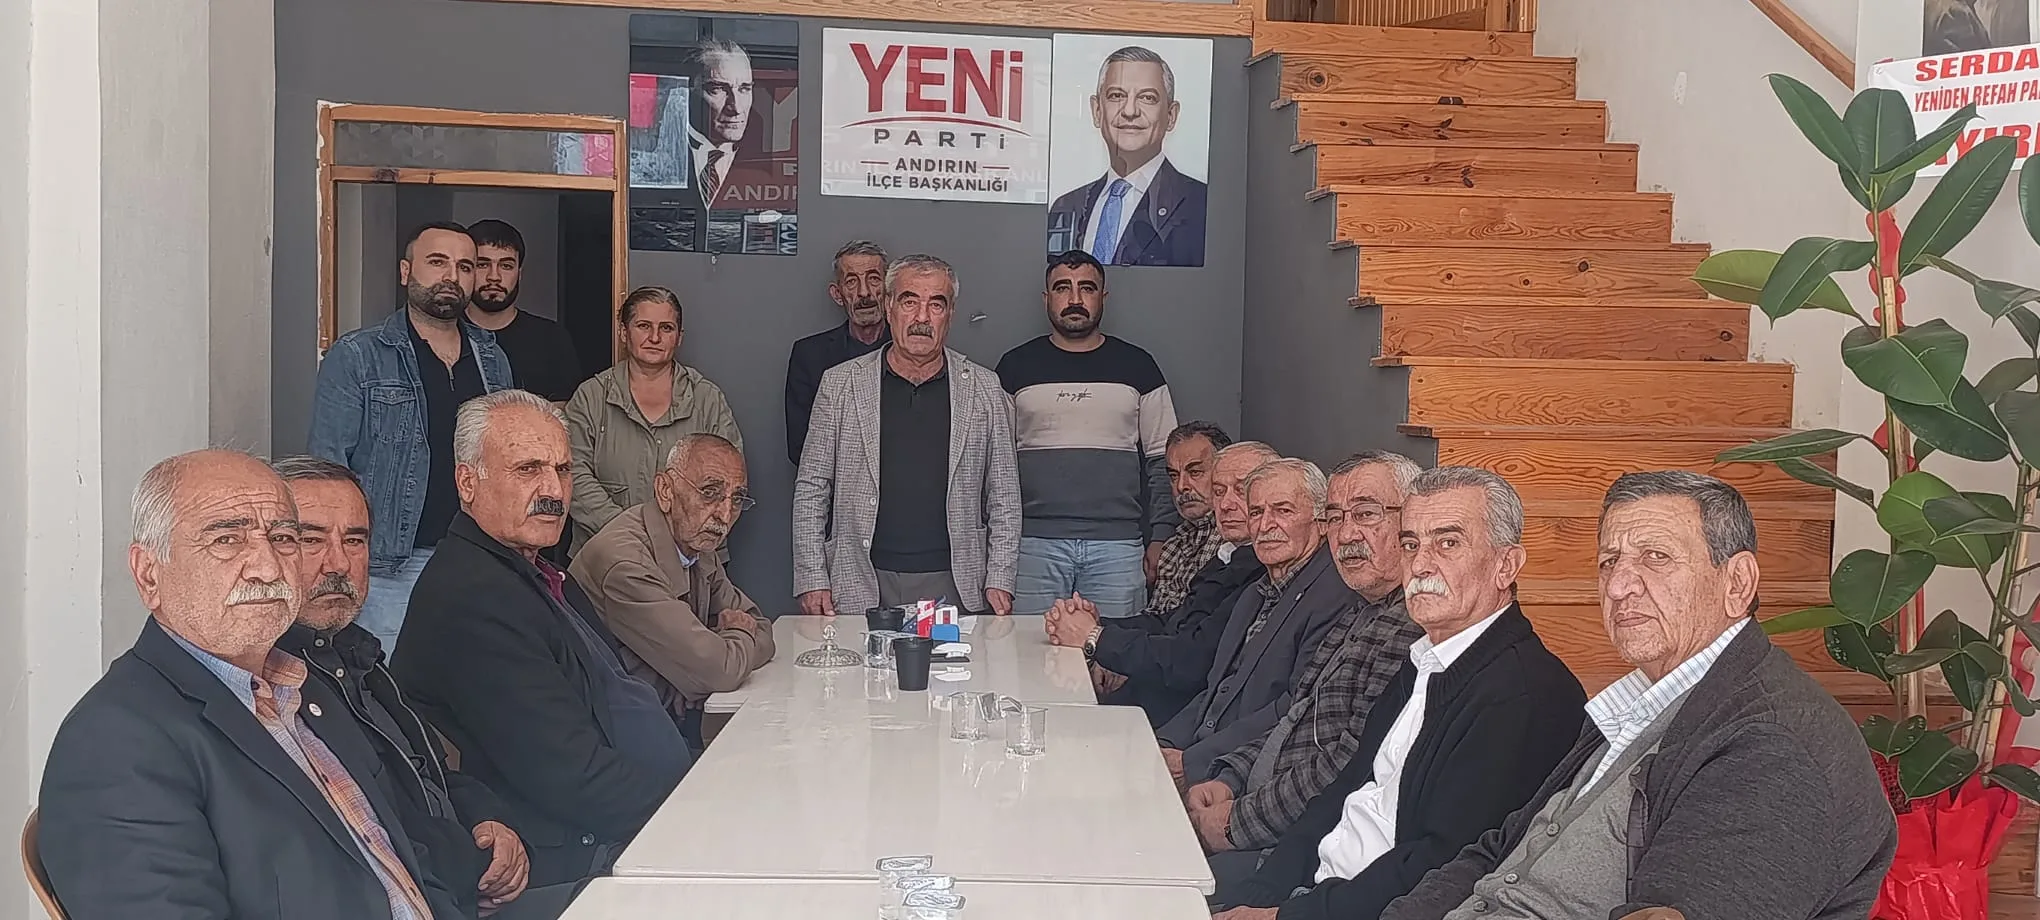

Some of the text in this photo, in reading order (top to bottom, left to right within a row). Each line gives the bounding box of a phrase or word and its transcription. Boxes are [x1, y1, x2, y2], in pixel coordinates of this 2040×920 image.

[1914, 79, 2040, 113] YENİDEN REFAH PA
[895, 157, 978, 174] ANDIRIN
[866, 172, 902, 190] İLÇE
[908, 175, 1009, 192] BAŞKANLIĞI
